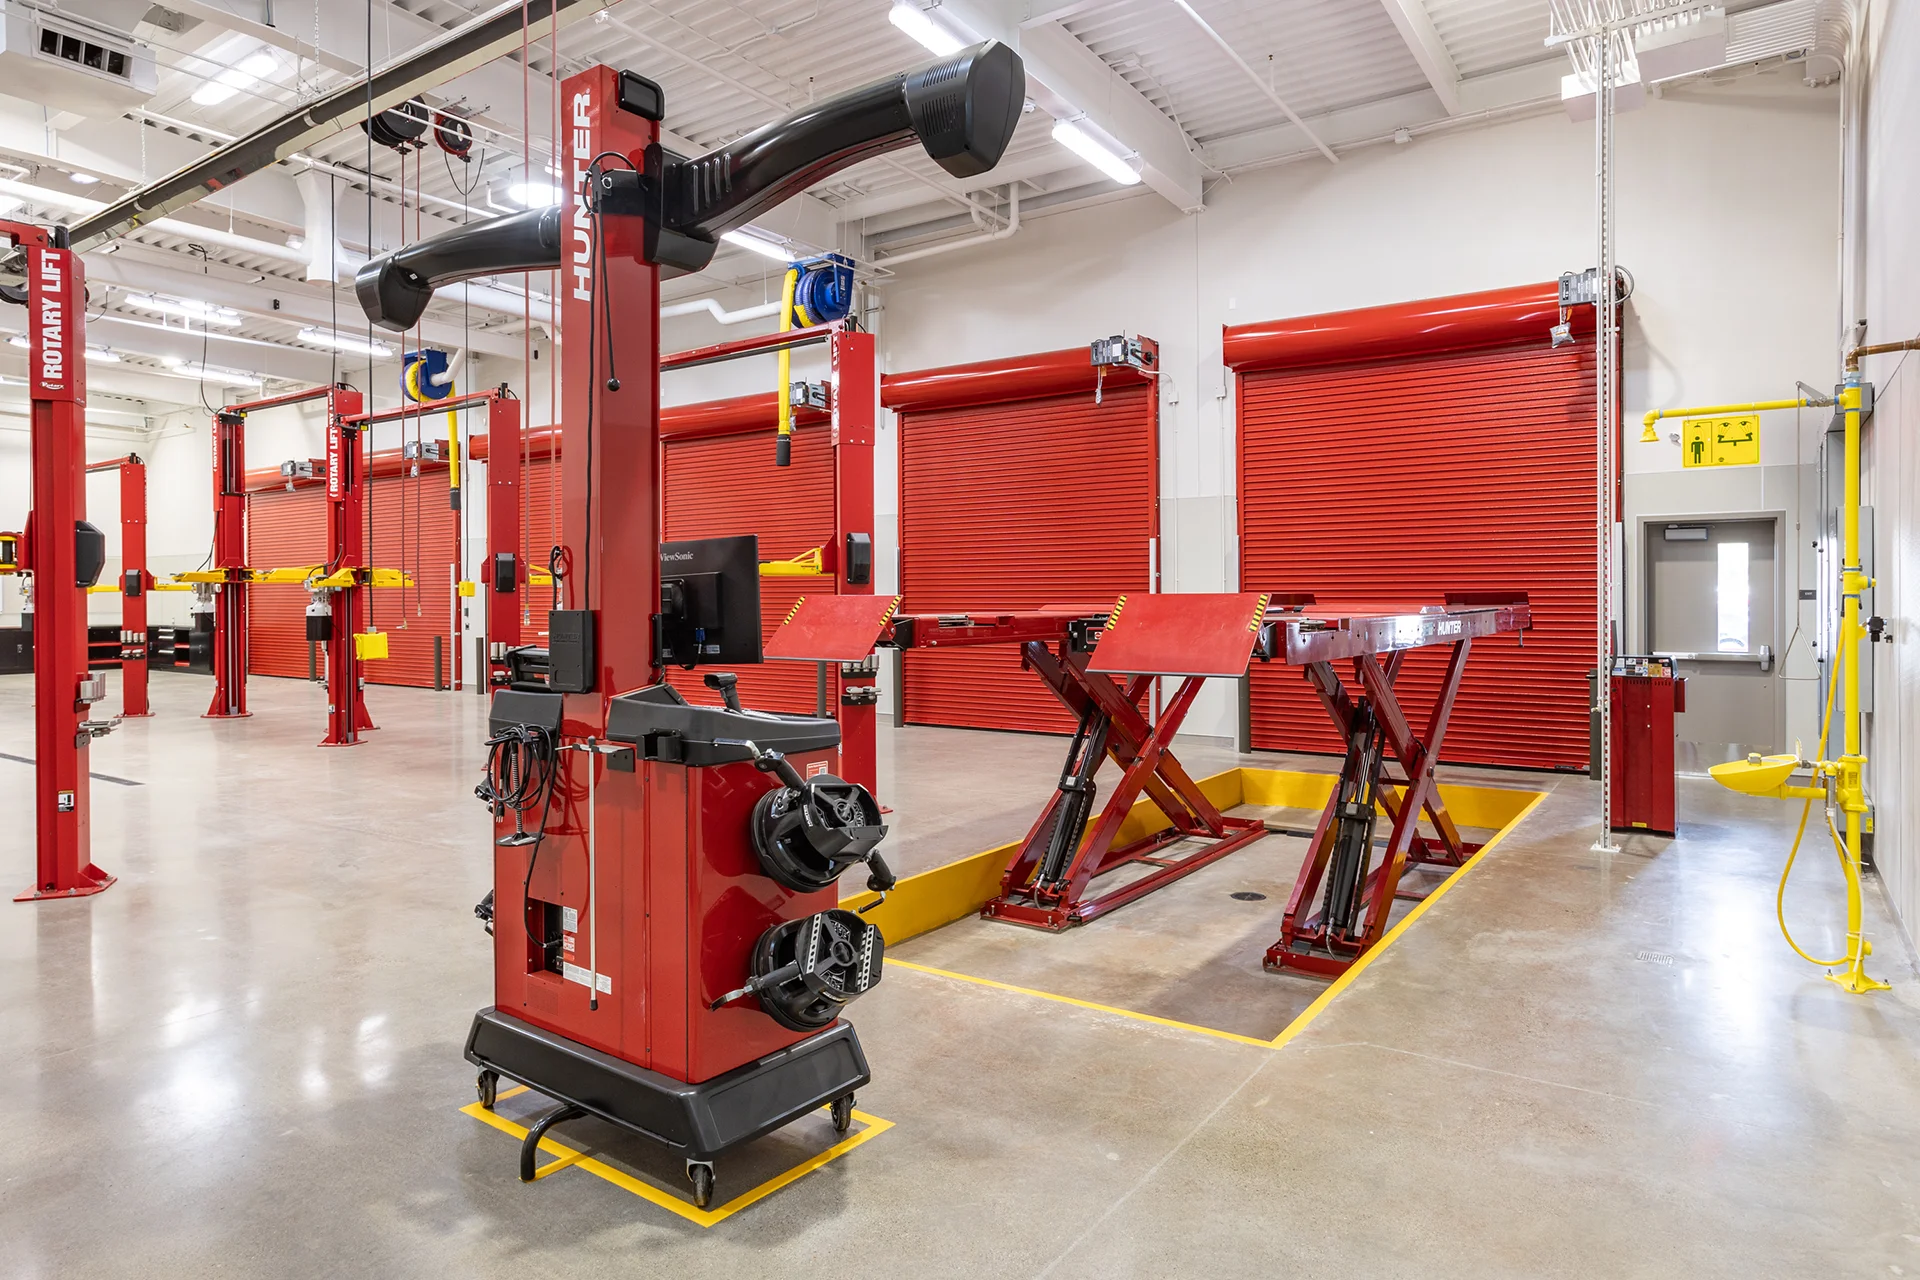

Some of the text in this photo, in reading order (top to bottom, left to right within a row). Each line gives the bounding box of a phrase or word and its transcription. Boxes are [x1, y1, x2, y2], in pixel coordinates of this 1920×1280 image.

[573, 92, 591, 302] HUNTER
[41, 249, 63, 379] ROTARY LIFT
[329, 428, 339, 450] LIFT
[329, 452, 339, 492] ROTARY
[660, 551, 694, 562] ViewSonic
[1437, 620, 1462, 636] HUNTER
